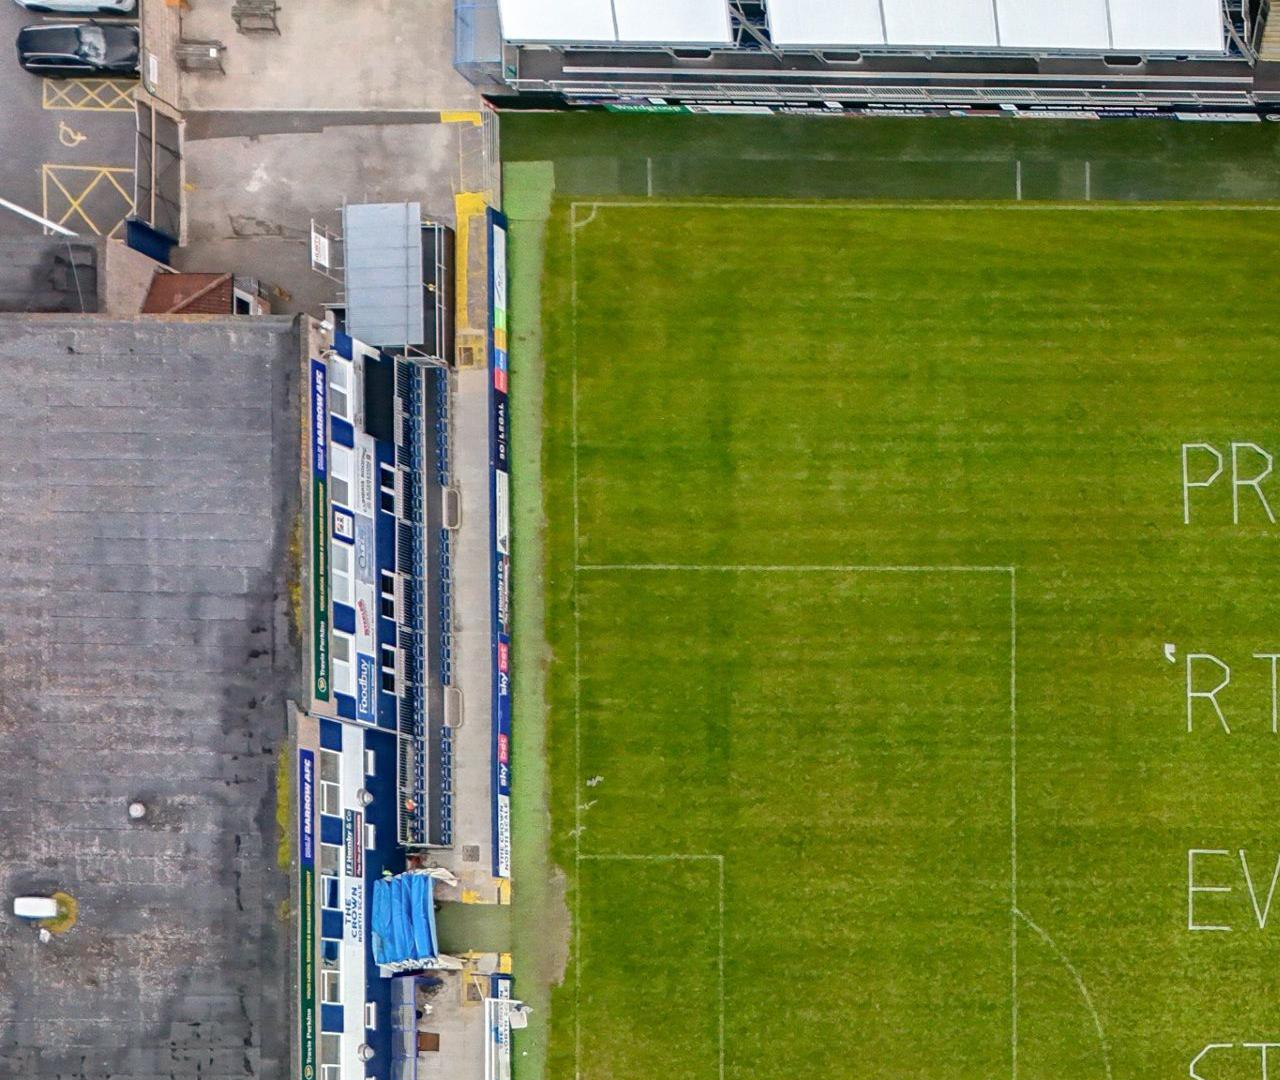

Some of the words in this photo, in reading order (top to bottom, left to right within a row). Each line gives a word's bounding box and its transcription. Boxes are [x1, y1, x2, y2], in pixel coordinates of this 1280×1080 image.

[316, 370, 324, 394] AFC
[316, 393, 324, 446] BARROW
[498, 559, 504, 572] Co
[500, 645, 508, 670] bet
[357, 659, 369, 714] Foodbuy
[499, 671, 508, 696] sky
[500, 737, 508, 760] bet
[304, 758, 312, 782] AFC
[499, 763, 508, 787] sky
[304, 783, 312, 834] BARROW
[345, 810, 352, 822] Co
[345, 831, 353, 863] Hornby
